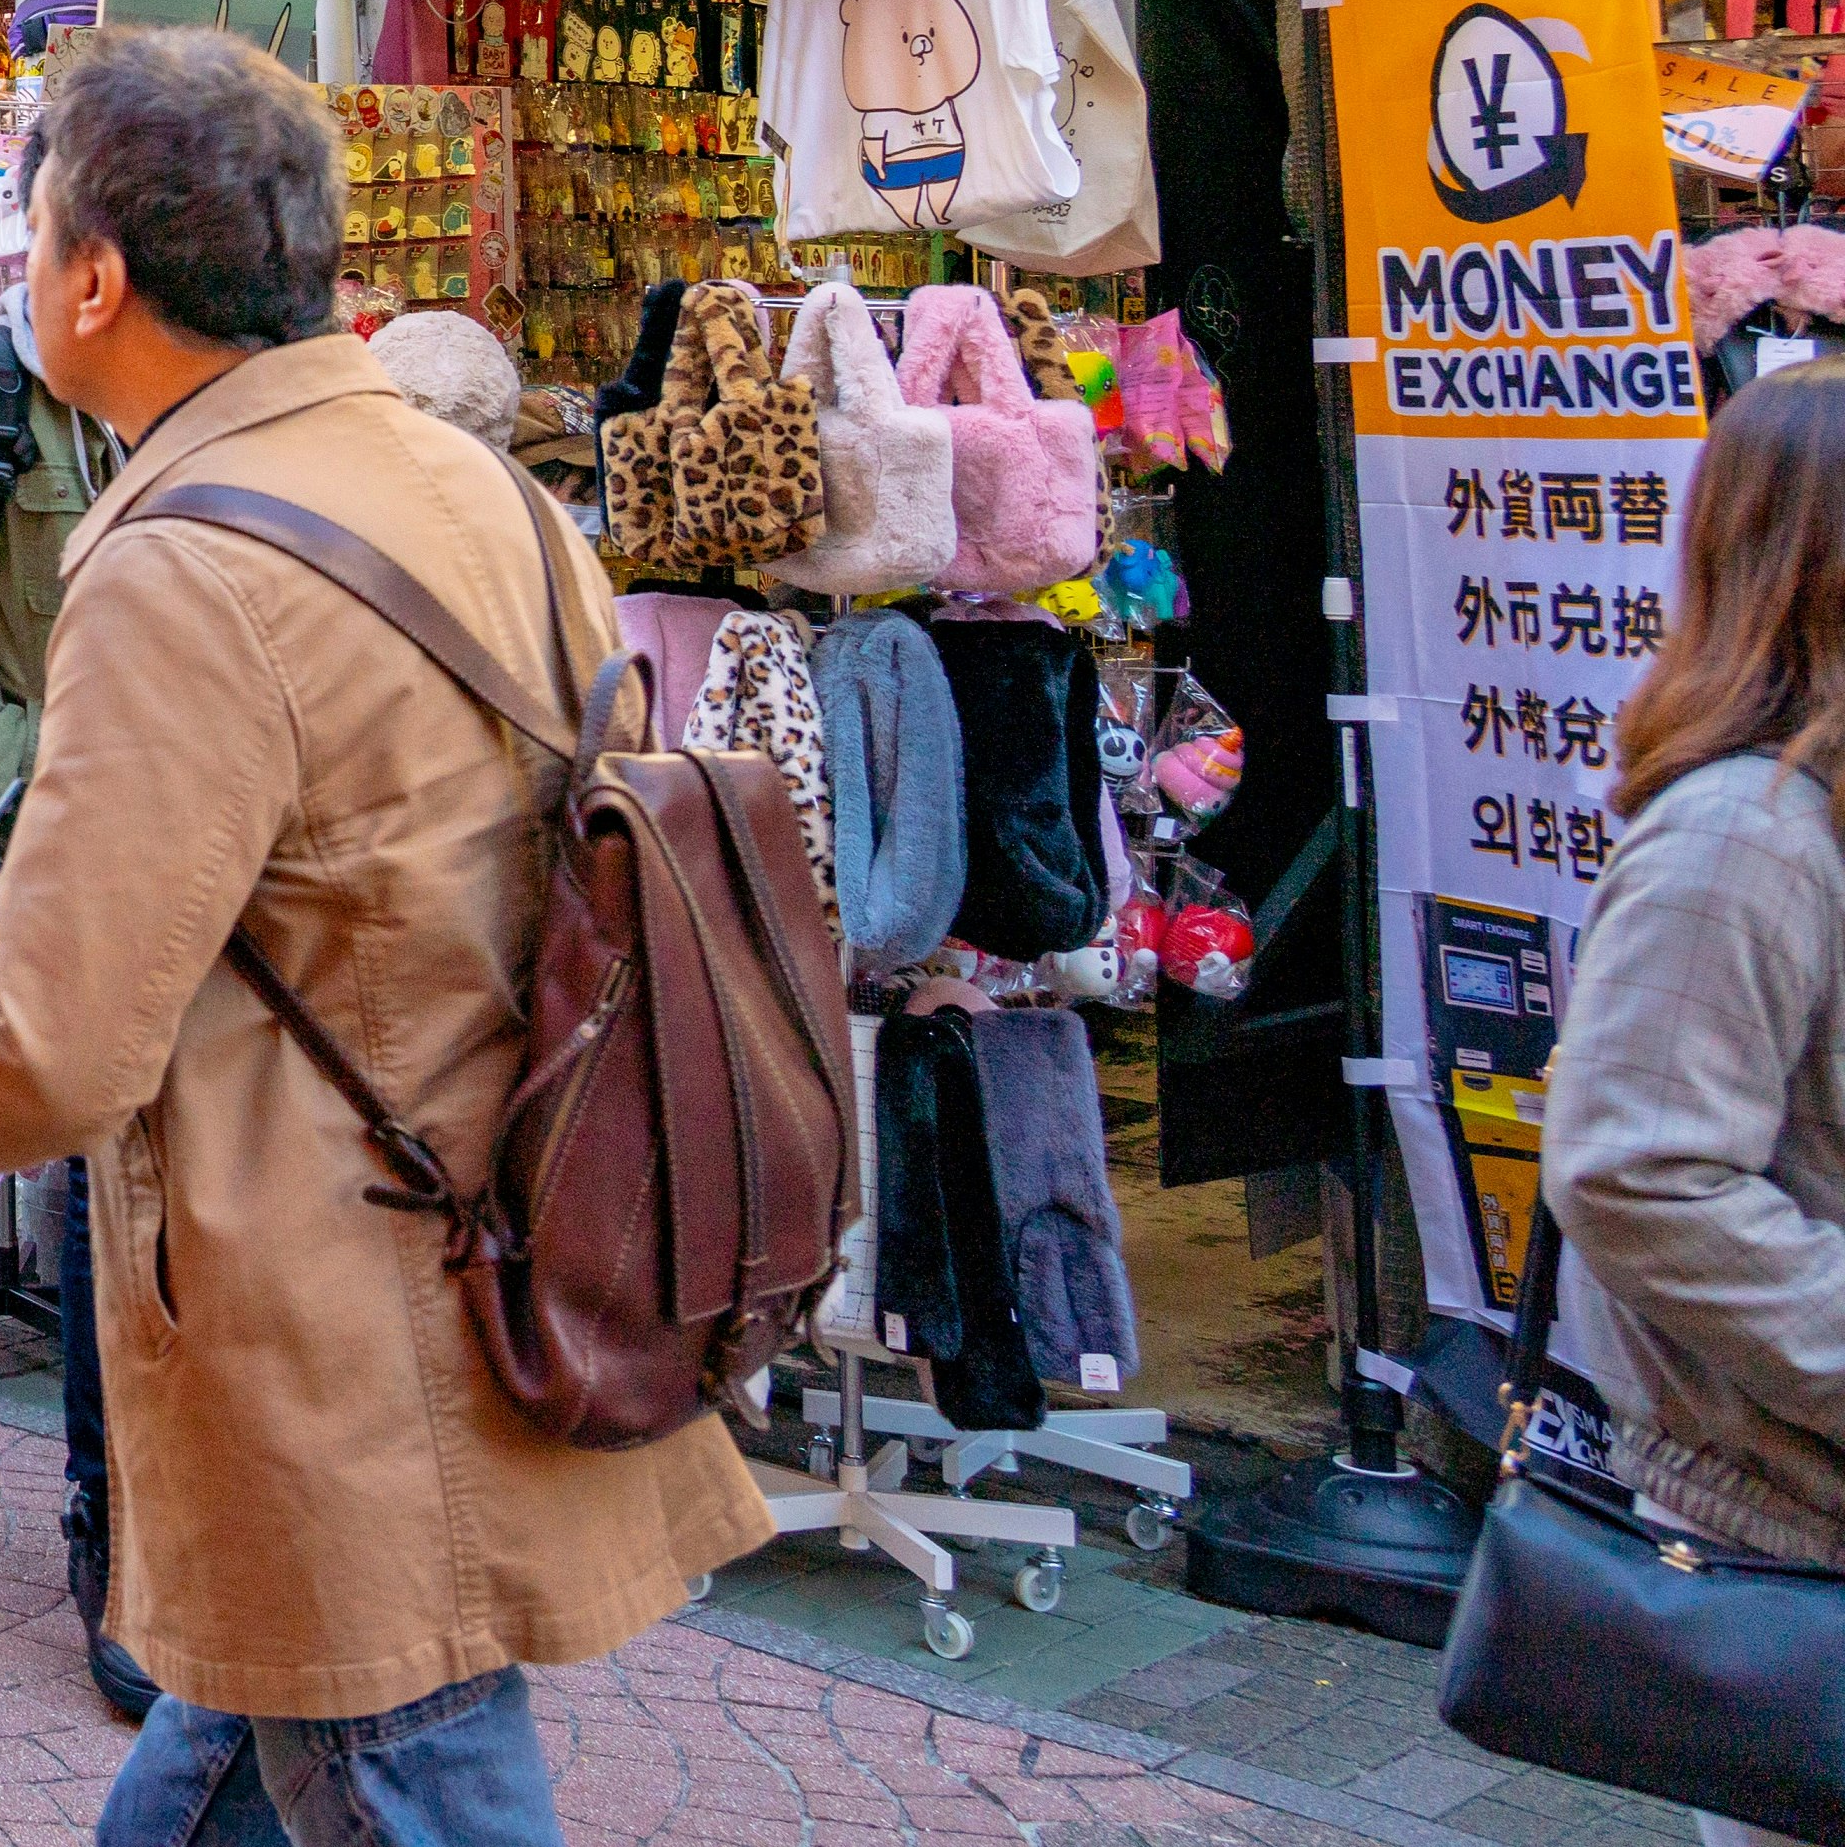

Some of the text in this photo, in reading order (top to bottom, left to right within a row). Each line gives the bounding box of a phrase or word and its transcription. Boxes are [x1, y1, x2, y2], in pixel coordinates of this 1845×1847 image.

[483, 47, 506, 60] BABY
[1661, 61, 1779, 100] SALE
[1382, 237, 1675, 336] MONEY
[1393, 348, 1696, 412] EXCHANGE
[1444, 466, 1668, 545] 外貨両替
[1462, 683, 1615, 766] 外幣兌
[1452, 916, 1532, 943] SMART EXCHANGE
